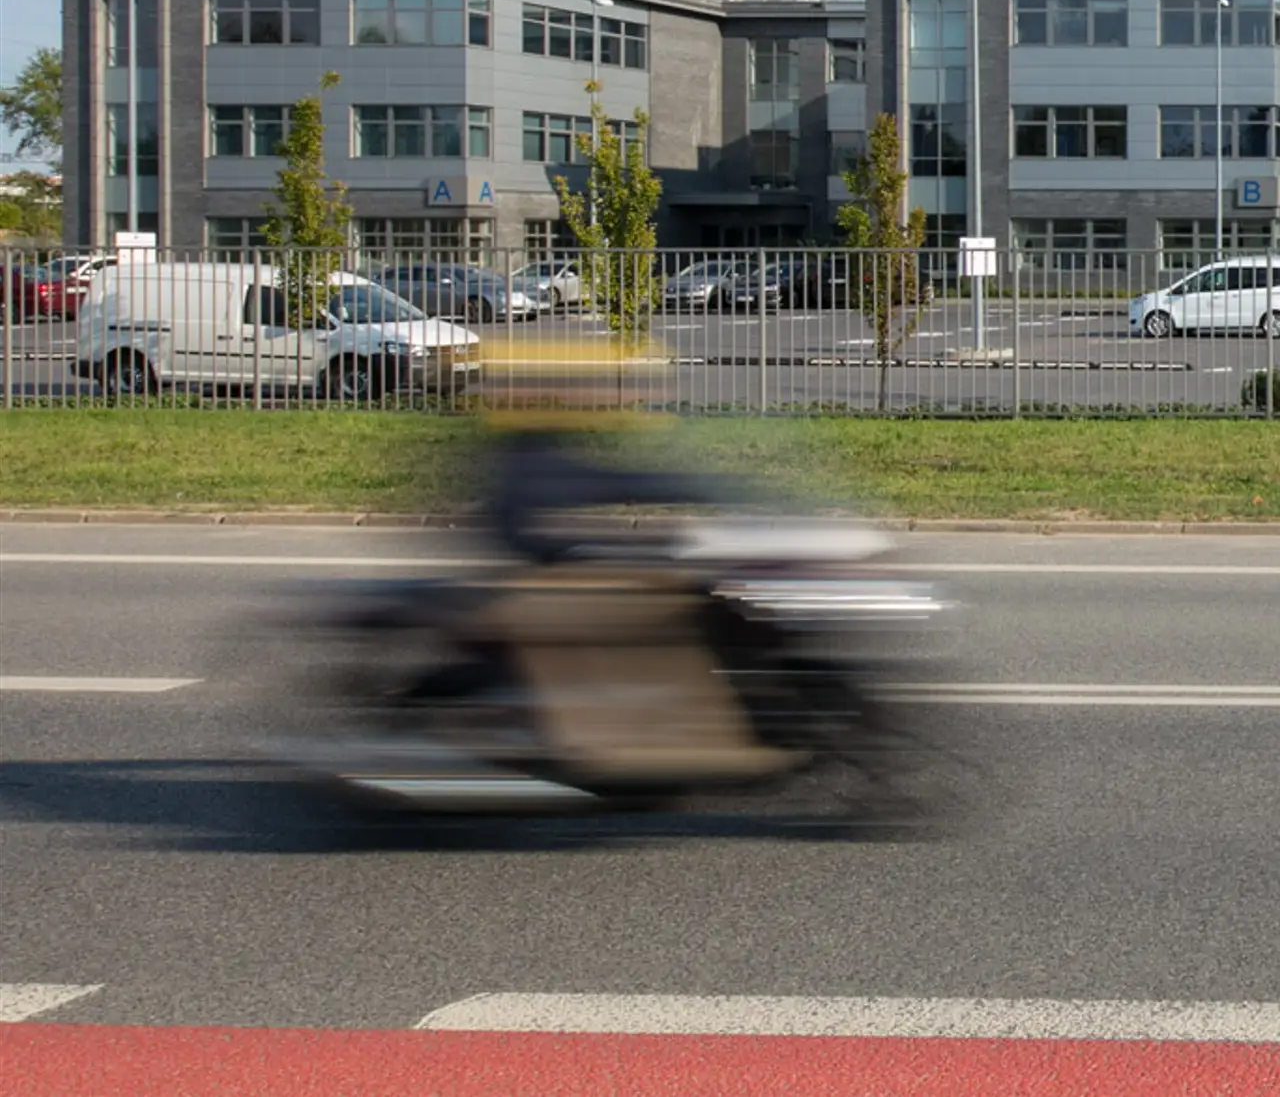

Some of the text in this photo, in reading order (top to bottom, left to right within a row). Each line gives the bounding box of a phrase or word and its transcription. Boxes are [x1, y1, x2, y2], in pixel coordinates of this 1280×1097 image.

[433, 180, 452, 202] A
[479, 181, 494, 203] A
[1244, 180, 1261, 203] B
